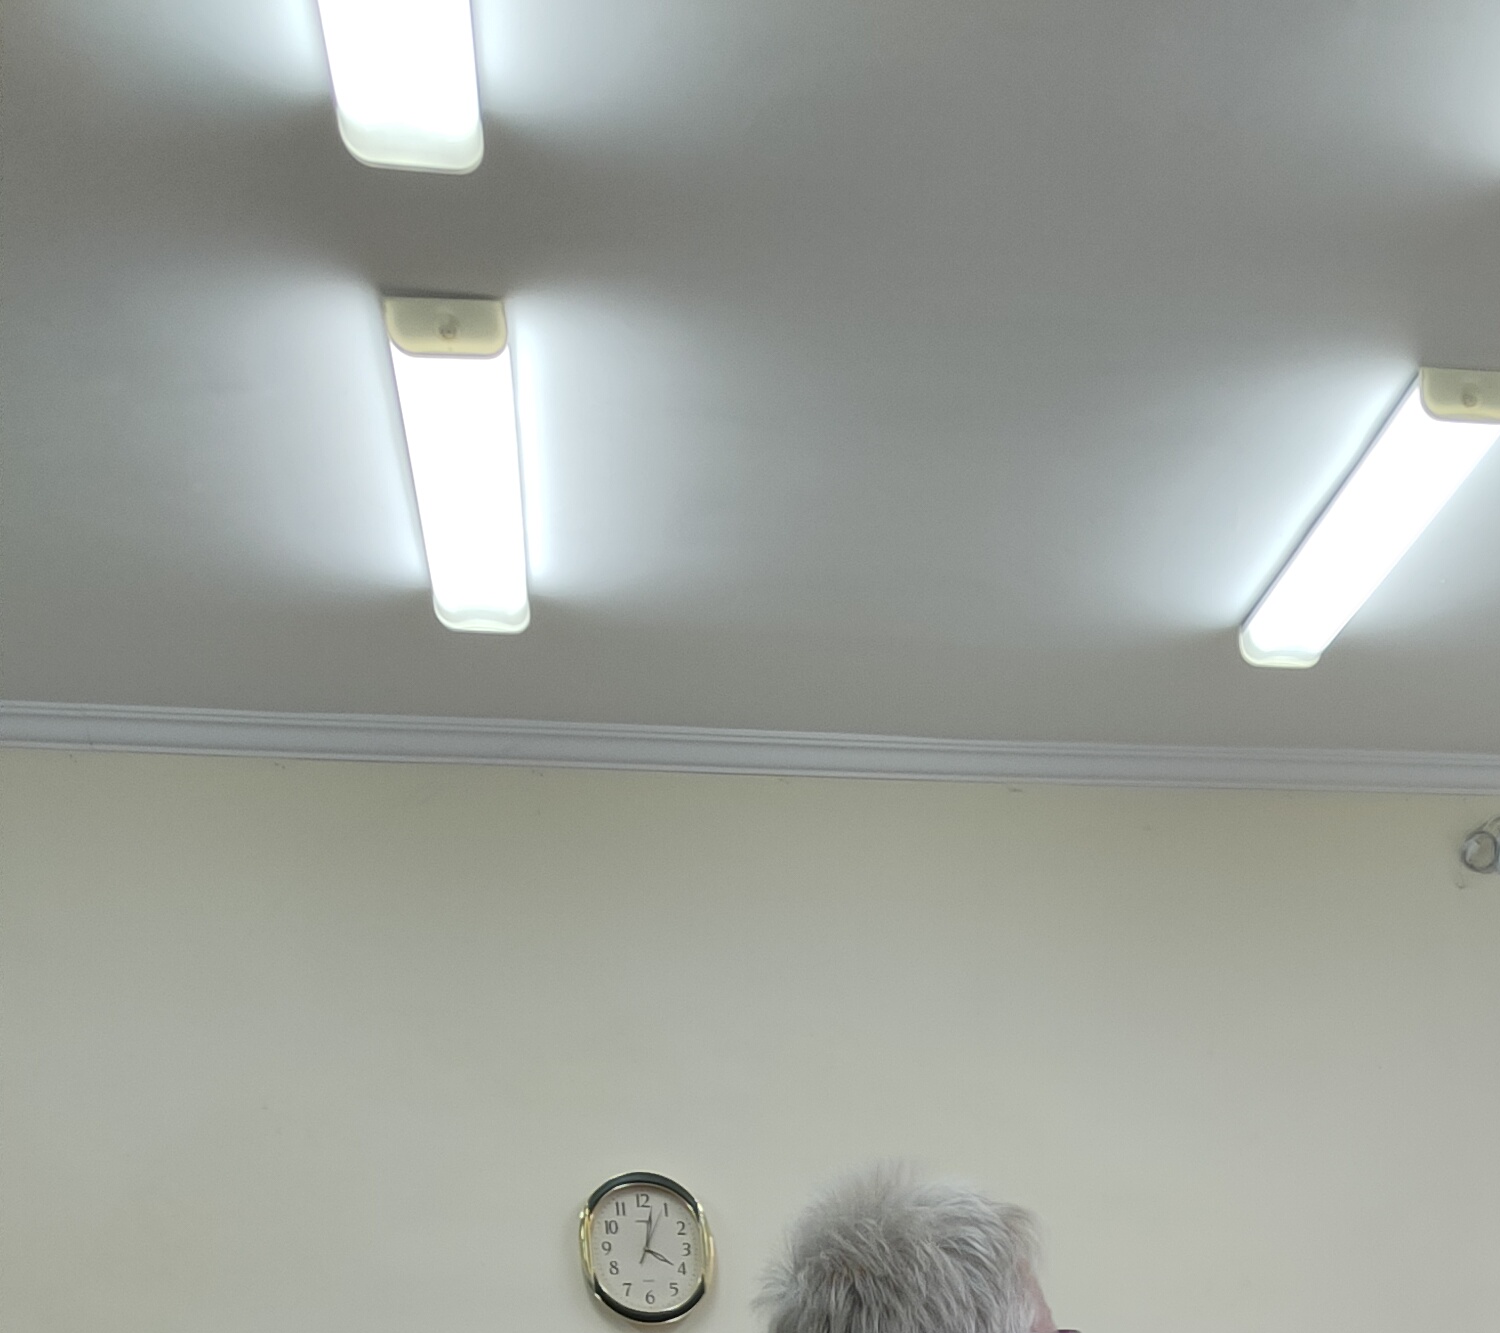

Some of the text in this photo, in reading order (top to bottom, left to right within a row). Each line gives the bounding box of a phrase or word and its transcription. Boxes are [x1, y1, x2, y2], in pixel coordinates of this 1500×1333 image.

[636, 1193, 651, 1209] 12
[615, 1202, 626, 1217] 11
[663, 1203, 669, 1217] 1
[604, 1220, 618, 1235] 10
[676, 1221, 686, 1236] 2
[602, 1241, 612, 1256] 9
[682, 1242, 691, 1257] 3
[609, 1260, 619, 1275] 8
[678, 1261, 686, 1275] 4
[622, 1282, 632, 1297] 7
[645, 1289, 655, 1304] 6
[669, 1282, 679, 1297] 5
